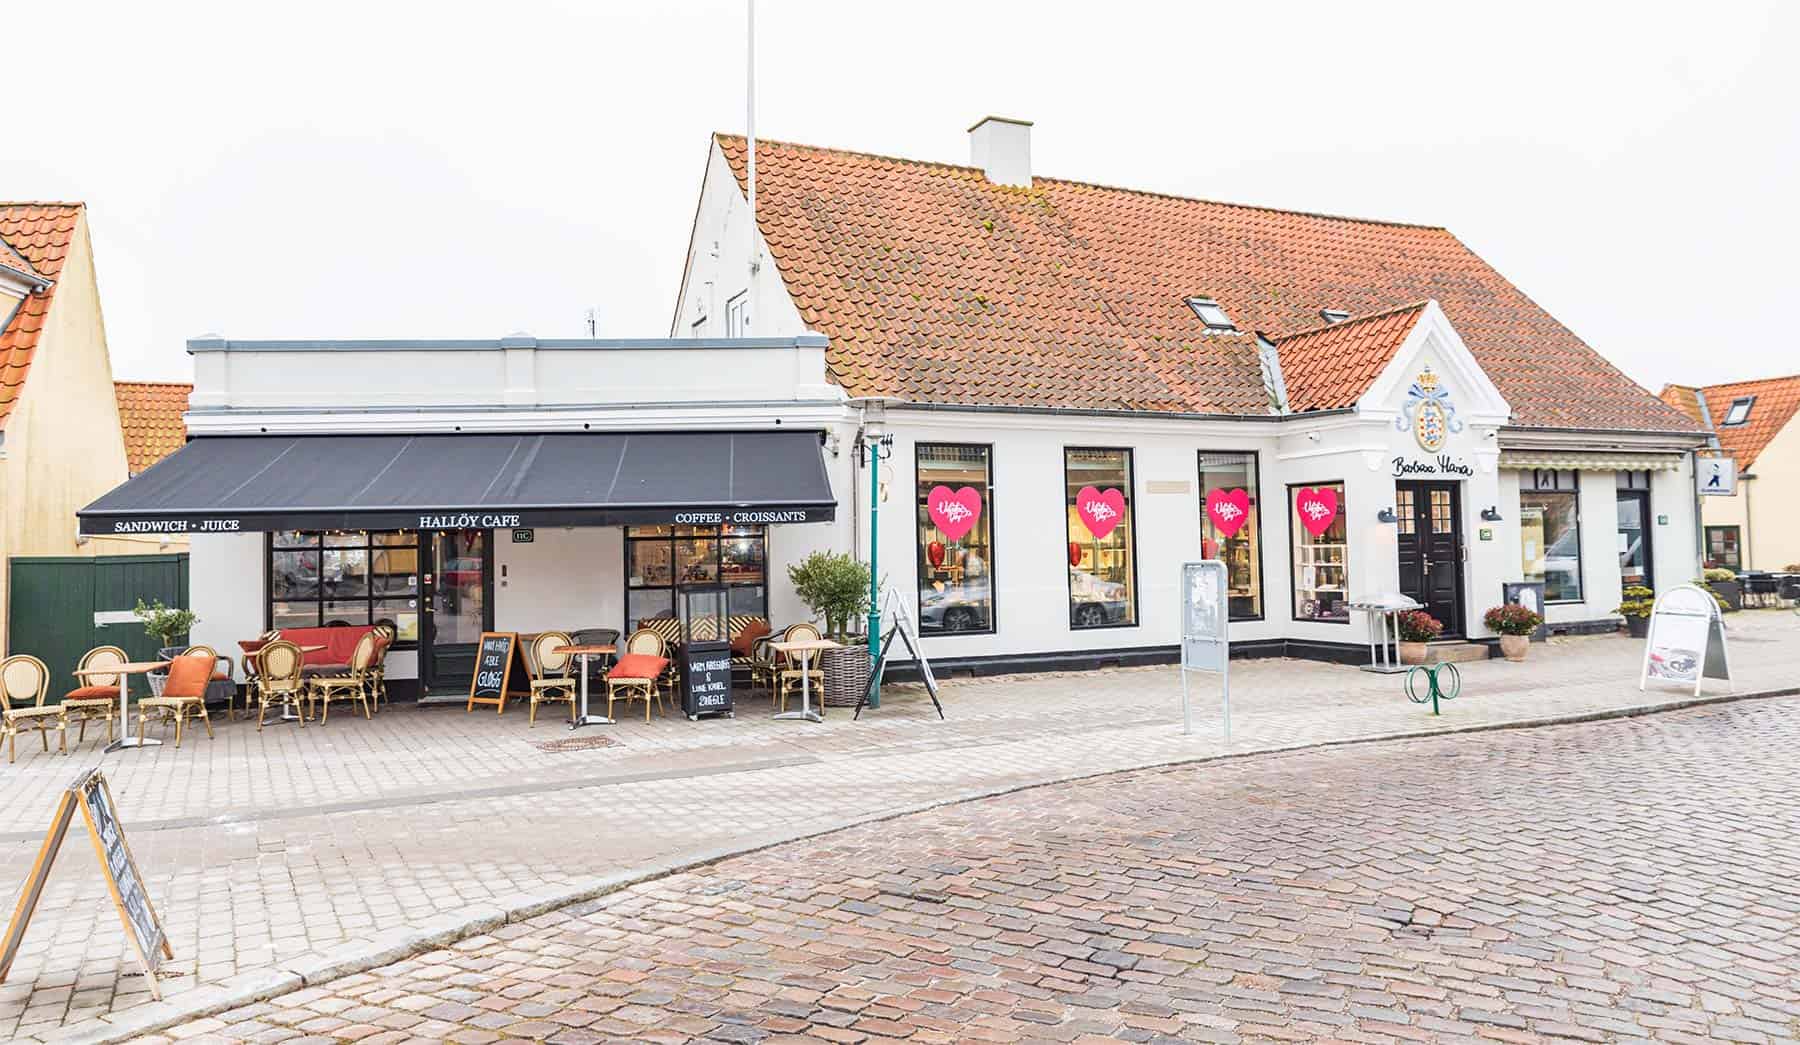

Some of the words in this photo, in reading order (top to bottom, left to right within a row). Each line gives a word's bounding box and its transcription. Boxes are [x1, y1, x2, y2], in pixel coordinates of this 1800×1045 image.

[419, 513, 480, 528] HALLÖY
[481, 514, 520, 527] CAFE
[675, 512, 722, 524] COFFEE
[733, 511, 807, 522] CROISSANTS
[114, 520, 188, 532] SANDWICH
[200, 519, 240, 531] JUICE
